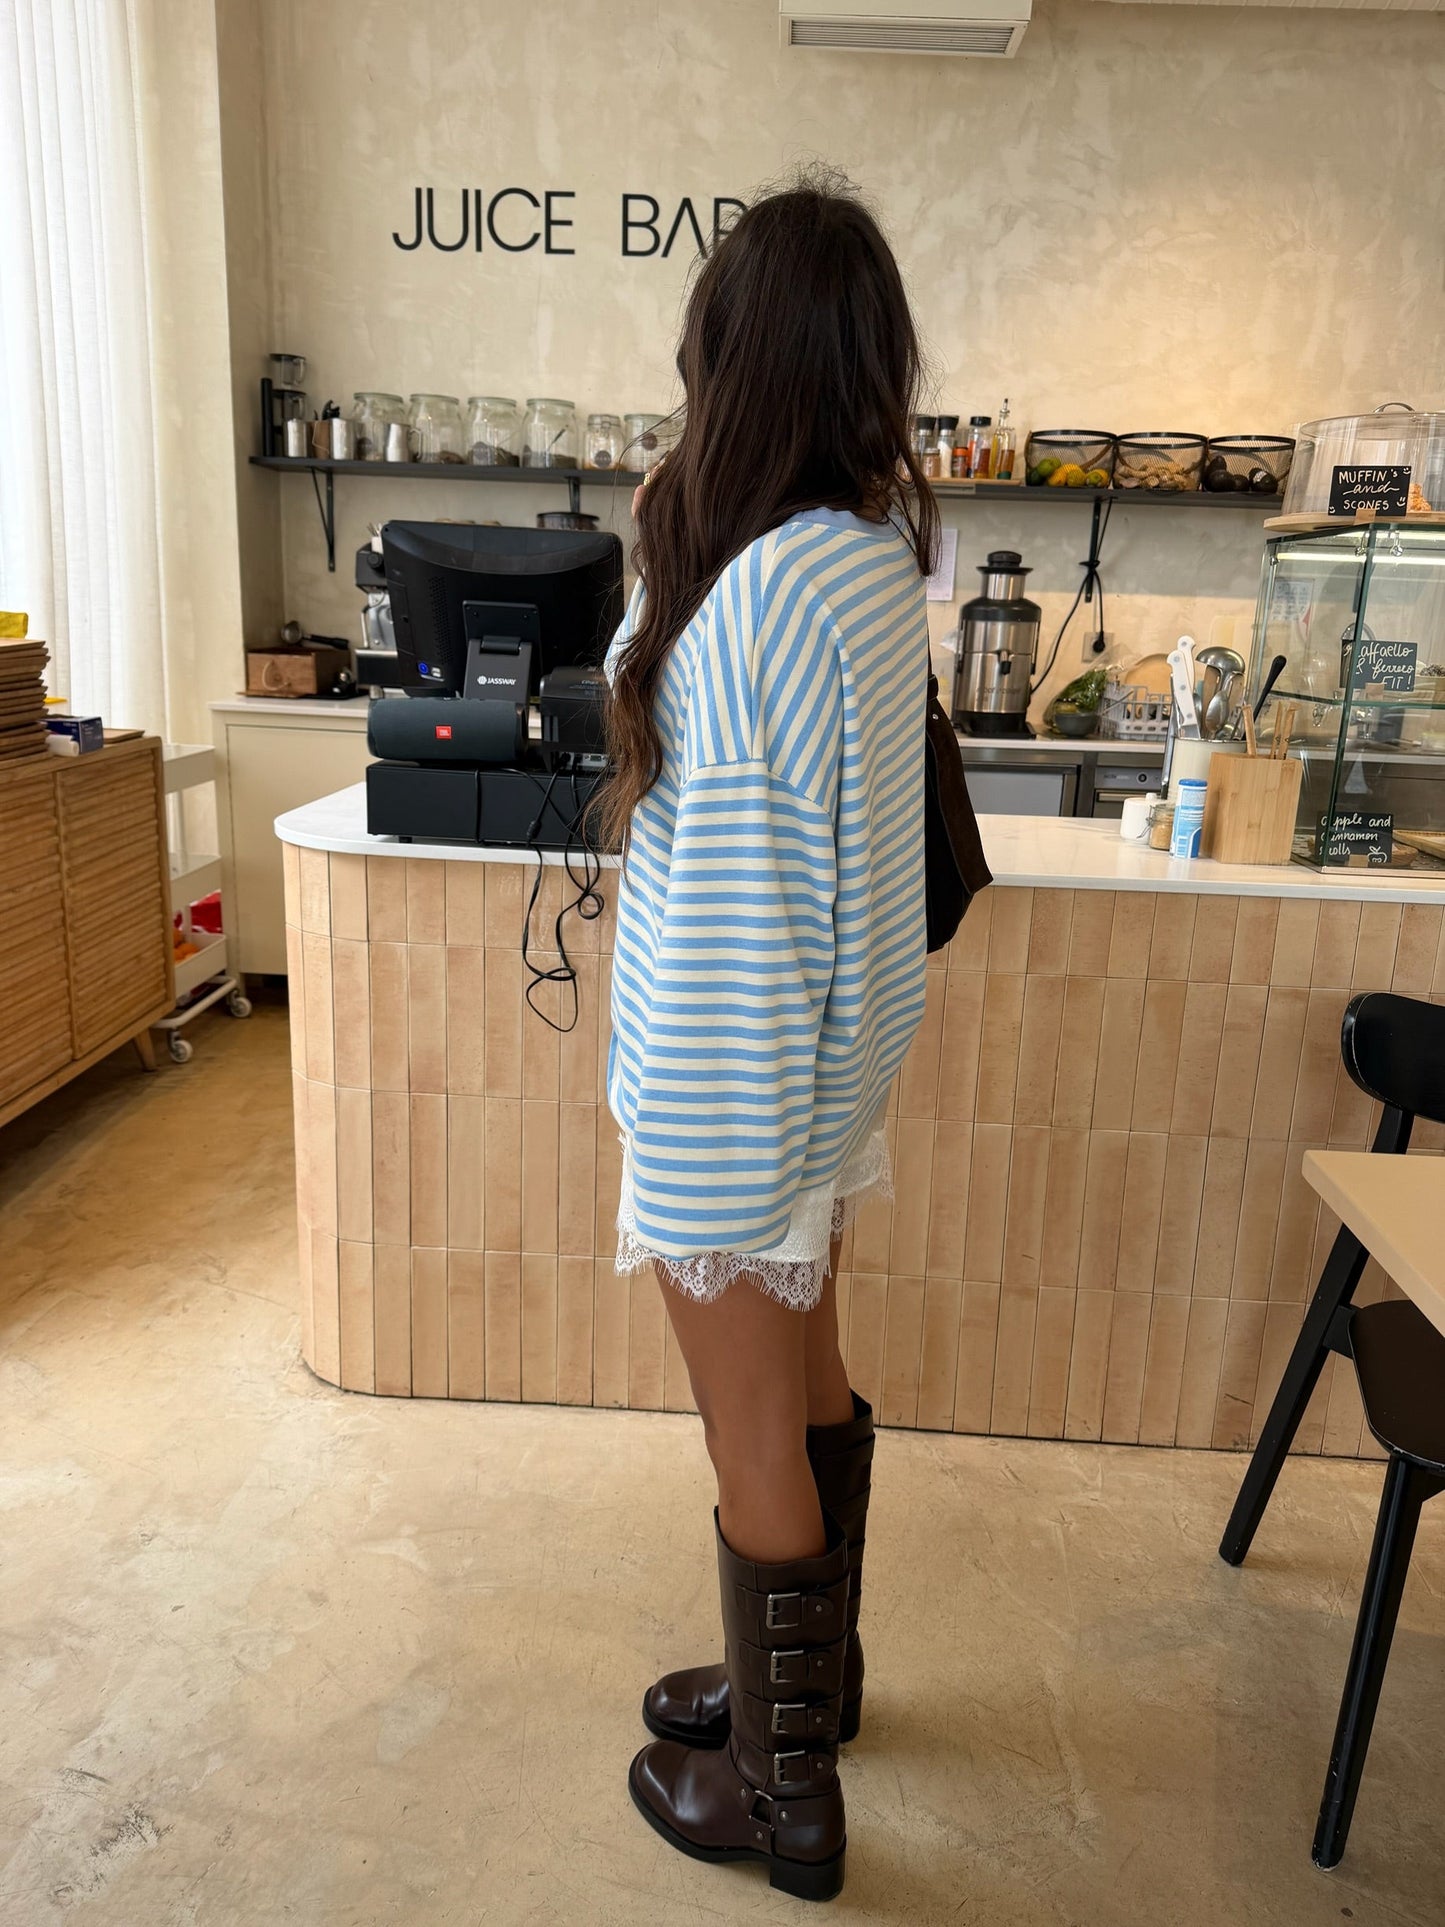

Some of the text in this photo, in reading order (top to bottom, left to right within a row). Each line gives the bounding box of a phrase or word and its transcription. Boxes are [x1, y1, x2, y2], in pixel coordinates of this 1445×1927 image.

[392, 187, 576, 255] JUICE
[1342, 481, 1400, 495] and
[1343, 500, 1390, 510] SCONES
[1368, 816, 1391, 827] and
